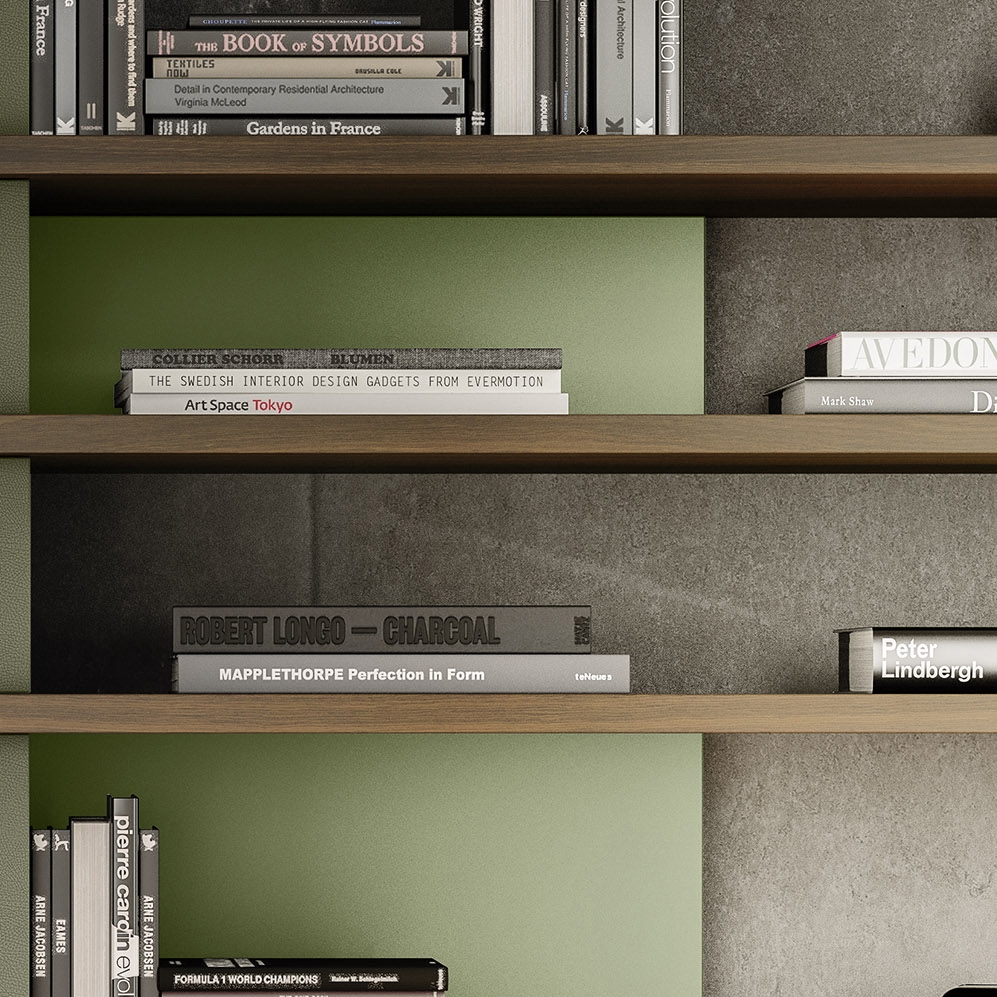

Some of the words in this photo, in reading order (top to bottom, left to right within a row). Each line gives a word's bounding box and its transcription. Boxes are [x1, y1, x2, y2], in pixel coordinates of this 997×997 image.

[577, 1, 587, 38] designers
[36, 4, 50, 56] France
[473, 8, 483, 47] WRIGHT
[616, 6, 625, 60] Architecture
[194, 42, 218, 53] THE
[222, 34, 288, 53] BOOK
[292, 42, 308, 53] OF
[312, 34, 425, 53] SYMBOLS
[166, 59, 215, 69] TEXTILES
[166, 69, 190, 78] NOW
[174, 85, 201, 95] Detail
[202, 85, 211, 95] in
[213, 85, 277, 97] Contemporary
[279, 85, 329, 95] Residential
[331, 85, 384, 95] Architecture
[175, 98, 209, 108] Virginia
[211, 98, 247, 107] McLeod
[246, 122, 308, 135] Gardens
[311, 122, 326, 135] in
[330, 122, 381, 135] France
[152, 354, 218, 365] COLLIER
[222, 354, 284, 365] SCHORR
[330, 354, 395, 365] BLUMEN
[149, 375, 171, 388] THE
[181, 375, 234, 388] SWEDISH
[243, 375, 304, 388] INTERIOR
[313, 375, 358, 388] DESIGN
[367, 375, 420, 388] GADGETS
[429, 375, 459, 388] FROM
[468, 375, 544, 388] EVERMOTION
[184, 399, 208, 411] Art
[210, 399, 249, 414] Space
[252, 399, 294, 414] Tokyo
[820, 396, 846, 406] Mark
[849, 396, 874, 406] Shaw
[179, 615, 268, 646] ROBERT
[273, 615, 346, 646] LONGO
[383, 615, 501, 646] CHARCOAL
[881, 637, 938, 659] Peter
[219, 668, 343, 681] MAPPLETHORPE
[349, 667, 424, 681] Perfection
[429, 667, 443, 681] in
[448, 667, 485, 681] Form
[575, 673, 612, 681] teNeues
[881, 661, 984, 683] Lindbergh
[114, 815, 134, 880] pierre
[116, 884, 134, 951] cardin
[55, 919, 66, 954] EAMES
[174, 974, 220, 985] FORMULA
[227, 974, 262, 985] WORLD
[264, 974, 319, 985] CHAMPIONS
